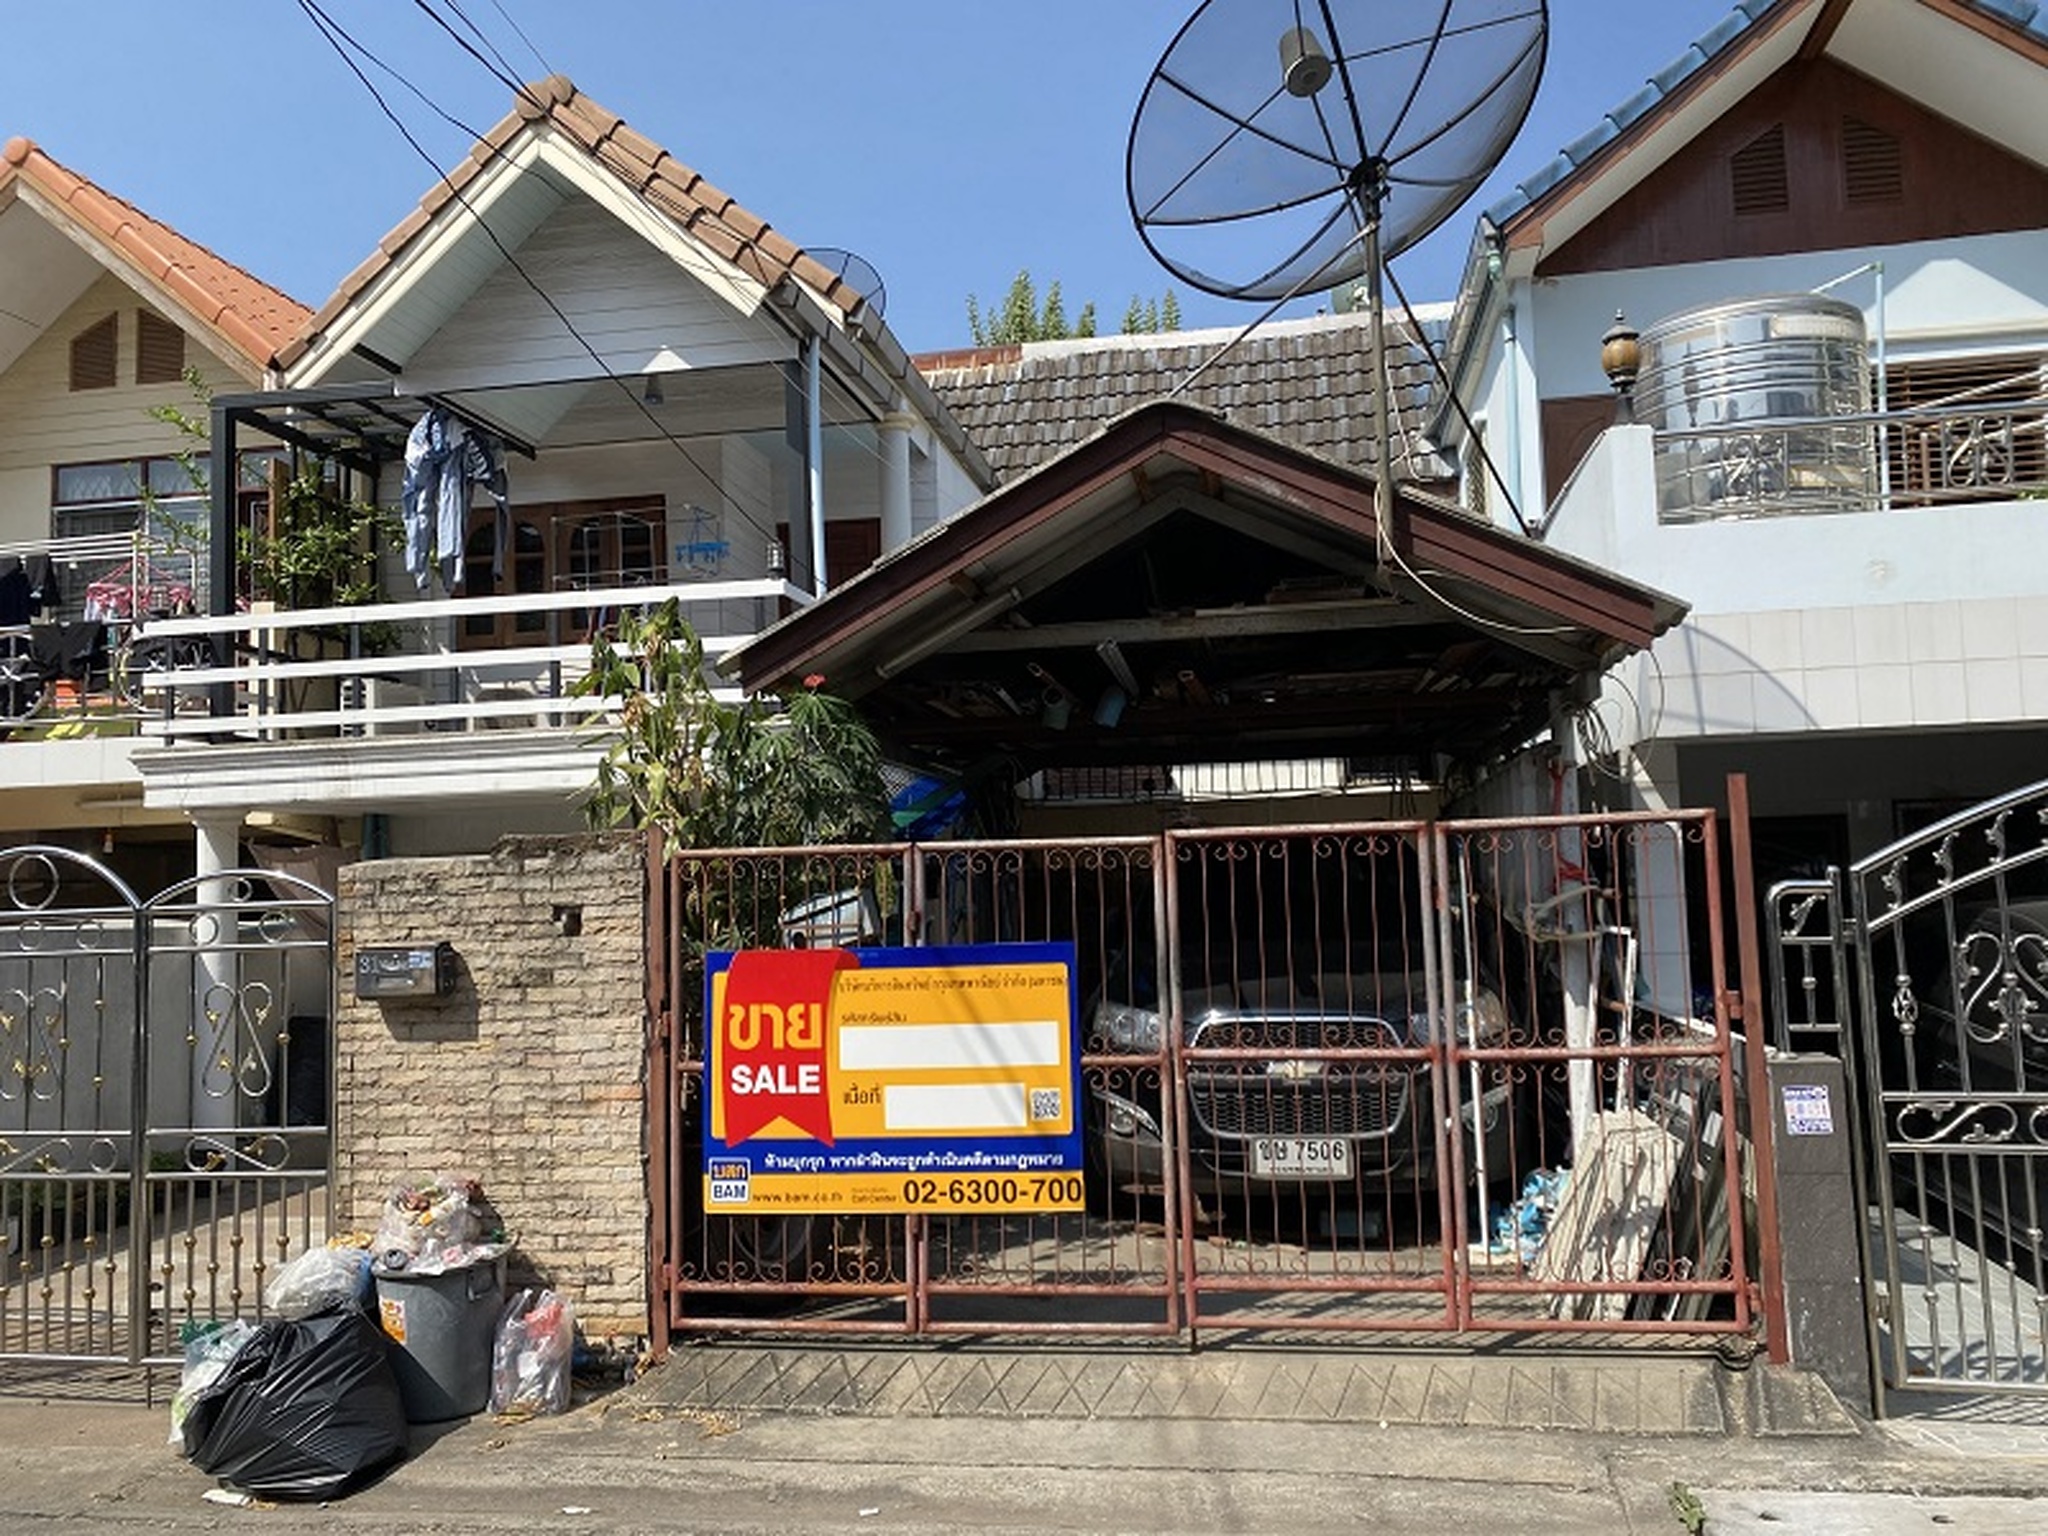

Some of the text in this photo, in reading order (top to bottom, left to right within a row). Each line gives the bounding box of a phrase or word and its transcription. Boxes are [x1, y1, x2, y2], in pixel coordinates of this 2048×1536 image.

[728, 1003, 822, 1050] ขาย
[731, 1064, 820, 1095] SALE
[1295, 1140, 1345, 1161] 7506
[764, 1152, 826, 1172] ห้ามบุกรุก
[713, 1184, 746, 1199] BAM
[752, 1191, 843, 1204] www.bam.co.th
[903, 1178, 1082, 1204] 02-6300-700
